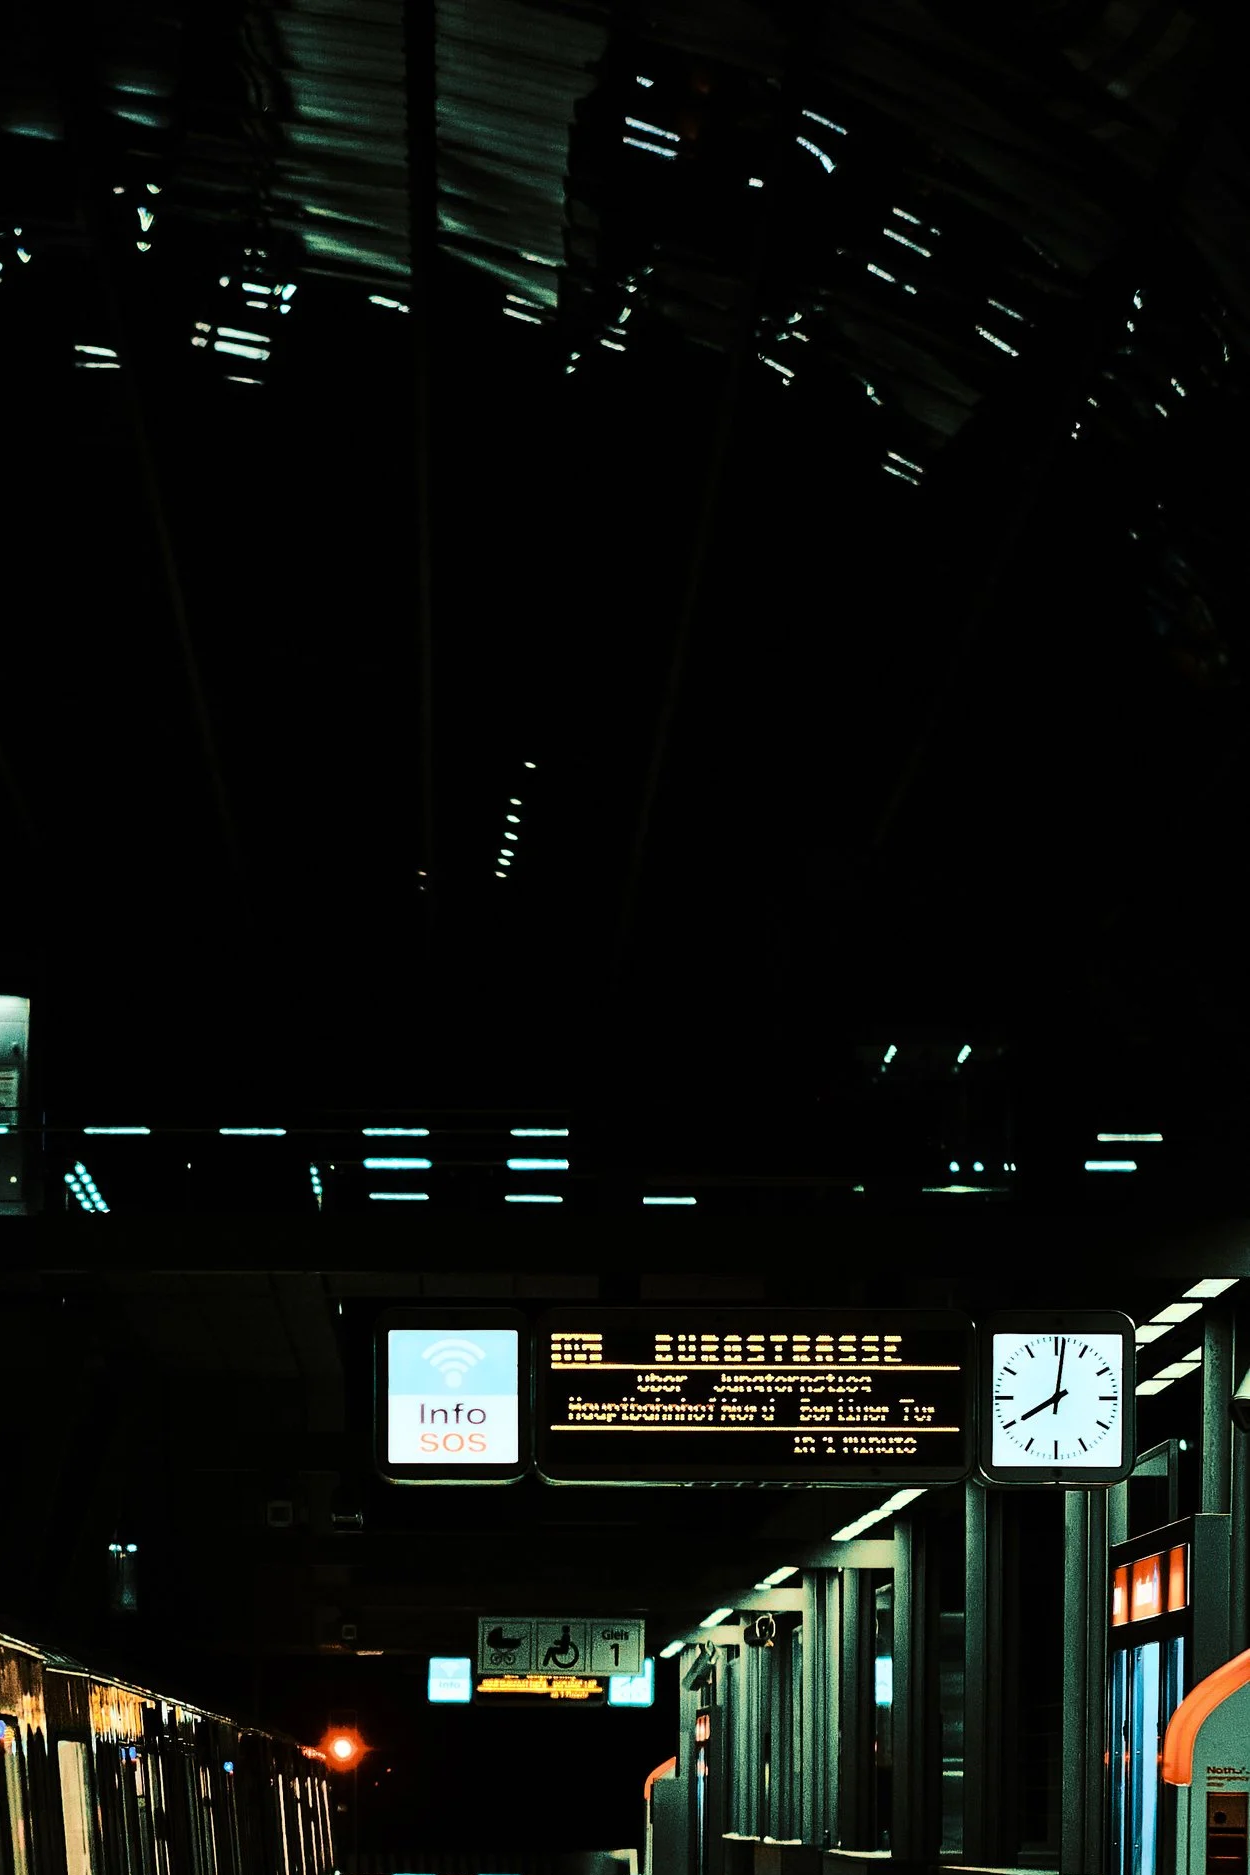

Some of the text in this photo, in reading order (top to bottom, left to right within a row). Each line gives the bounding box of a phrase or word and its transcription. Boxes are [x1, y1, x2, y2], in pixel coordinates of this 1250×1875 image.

[419, 1402, 487, 1425] Info
[420, 1432, 488, 1453] SOS
[601, 1629, 630, 1641] Gleis
[610, 1643, 620, 1667] 1
